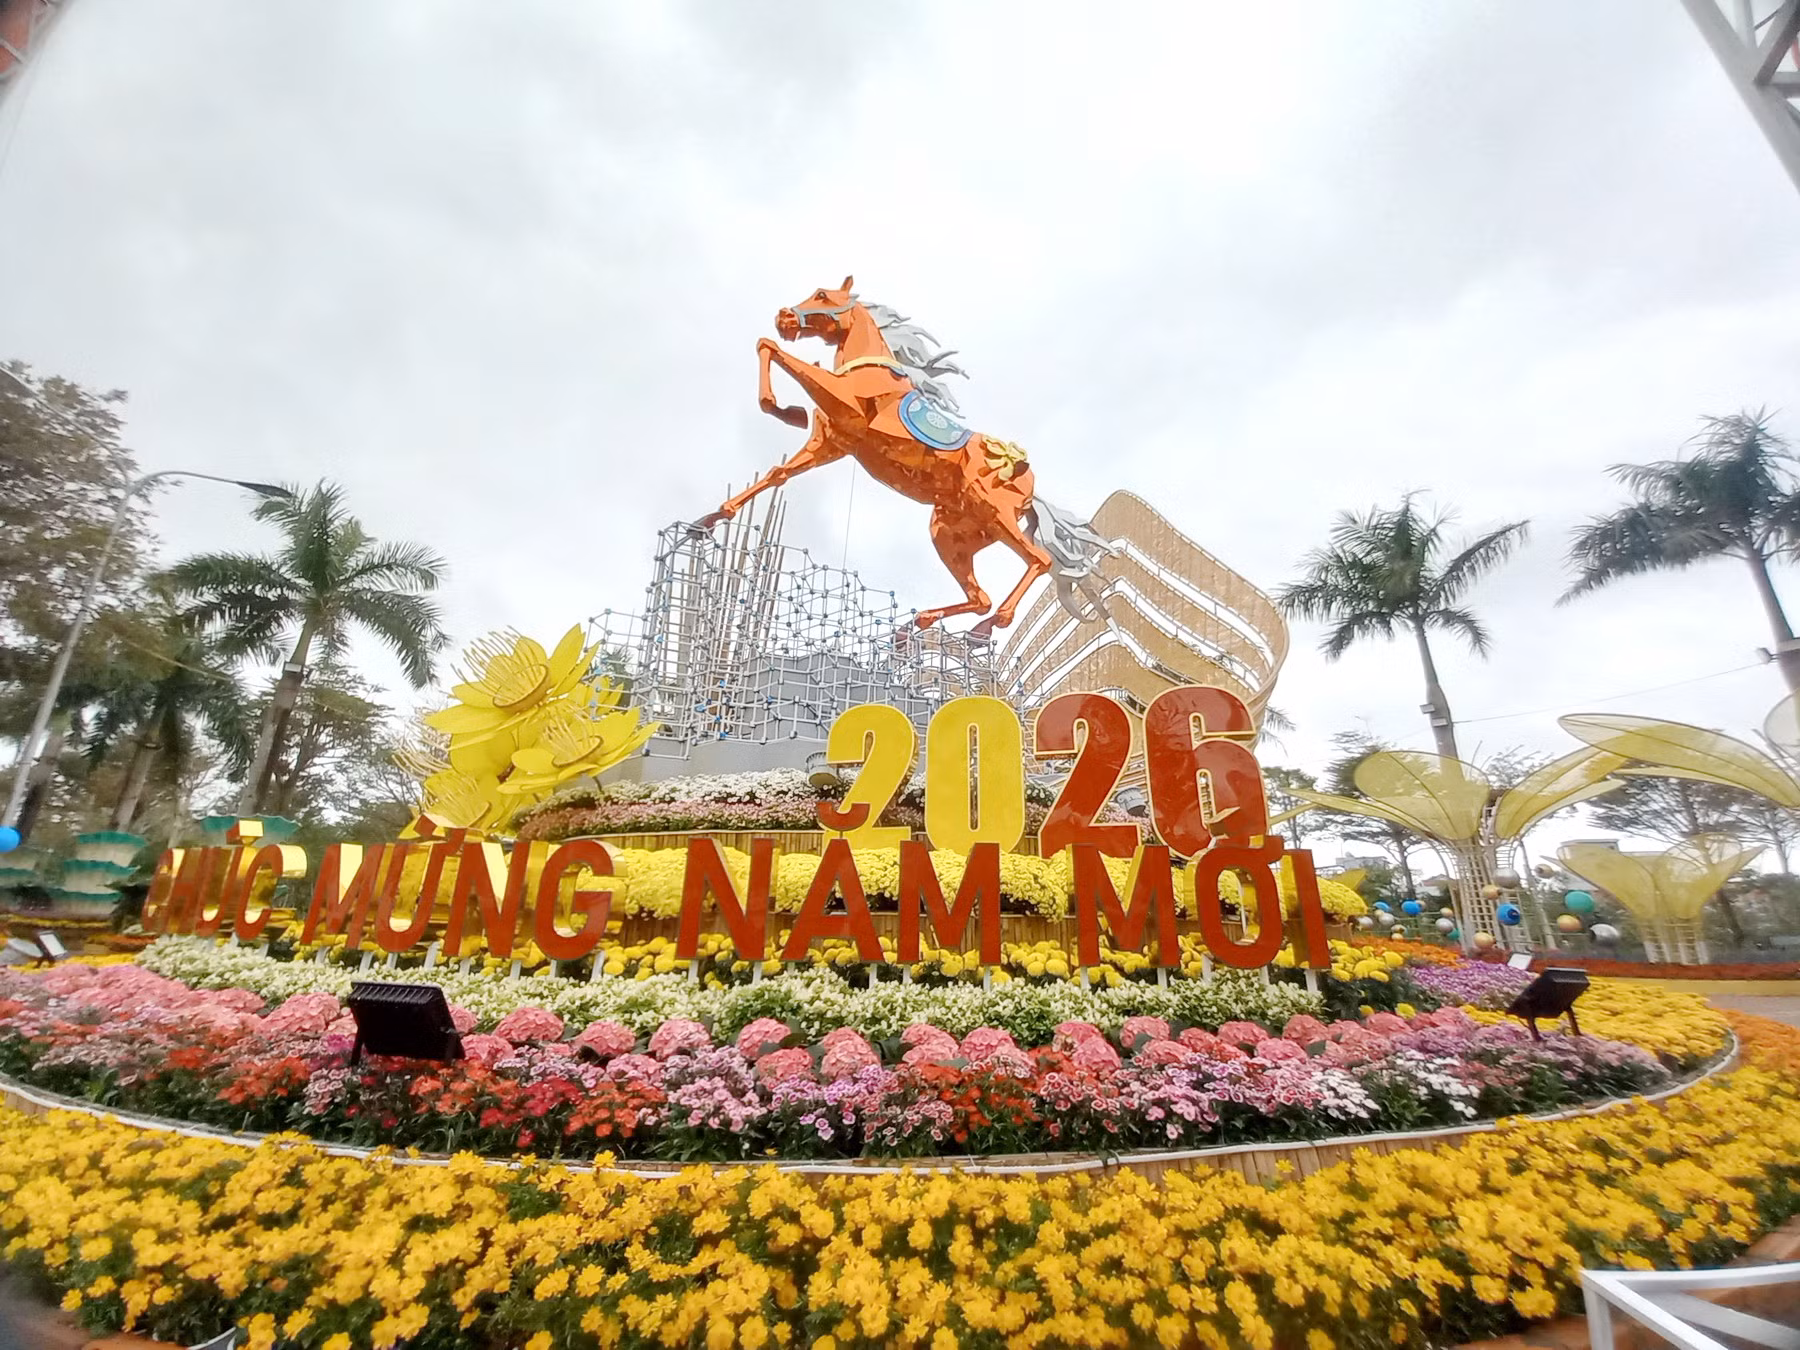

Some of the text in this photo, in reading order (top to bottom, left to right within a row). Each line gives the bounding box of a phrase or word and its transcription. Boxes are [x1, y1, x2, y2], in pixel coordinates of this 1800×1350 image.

[823, 684, 1270, 859] 2026
[301, 814, 615, 960] MỪNG
[675, 801, 1002, 965] NĂM
[1067, 805, 1333, 969] MỚI
